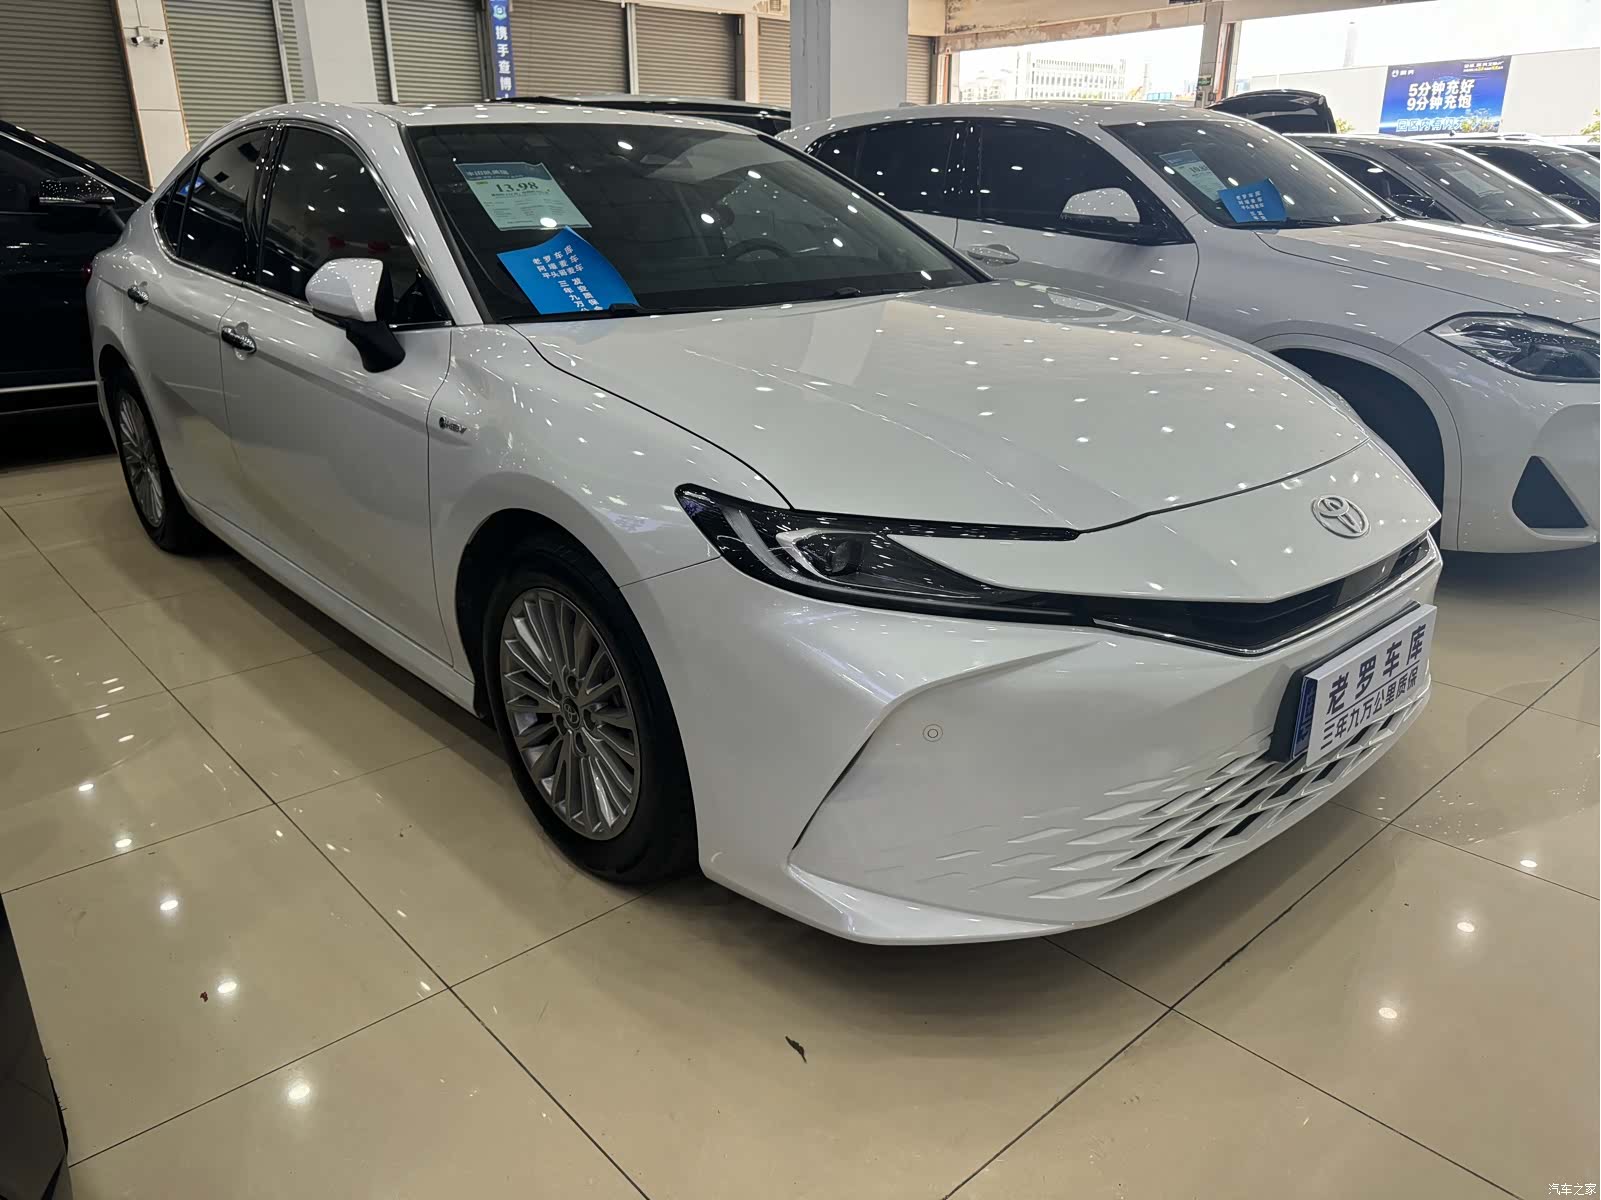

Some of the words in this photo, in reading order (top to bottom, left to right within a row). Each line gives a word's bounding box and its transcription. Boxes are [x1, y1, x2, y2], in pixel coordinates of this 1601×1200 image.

[495, 25, 512, 98] 携手查博
[1406, 94, 1472, 111] 9分钟充饱
[1408, 79, 1475, 98] 5分钟充好
[496, 181, 539, 193] 13.98
[1326, 623, 1426, 715] 老罗车库
[1320, 665, 1419, 751] 三年九万公里质保
